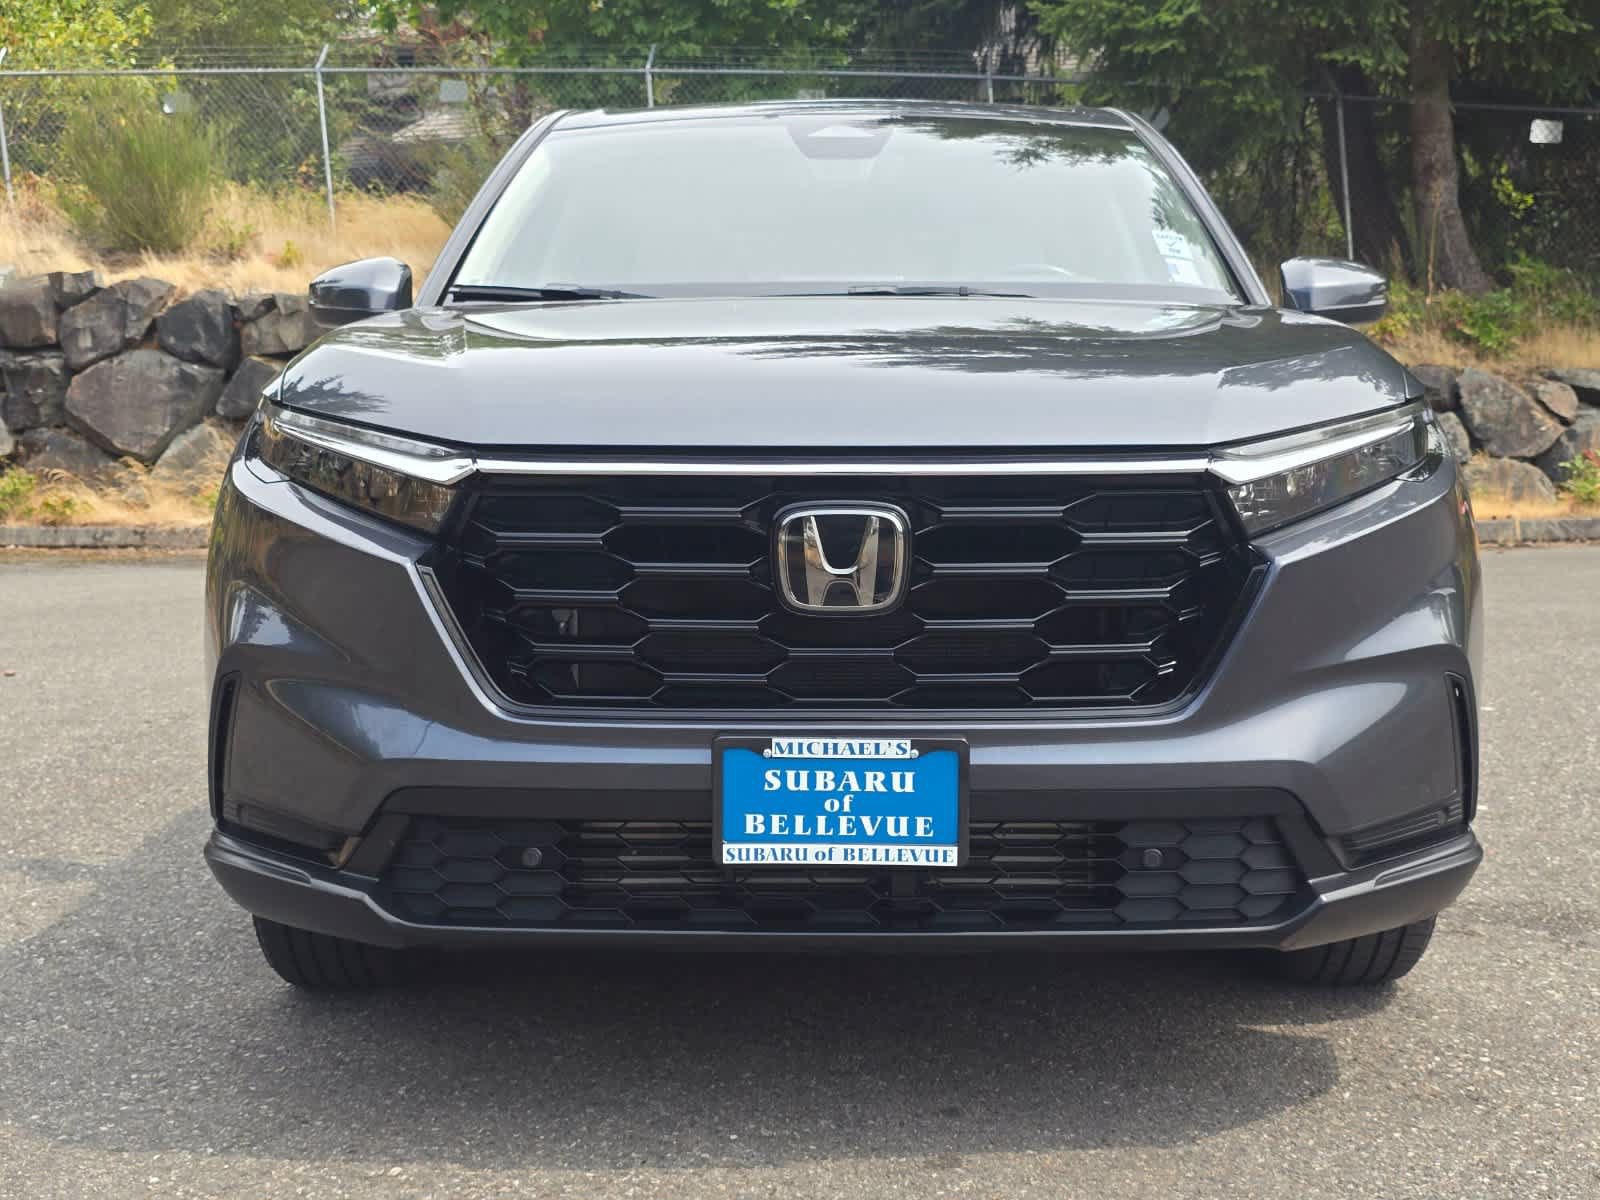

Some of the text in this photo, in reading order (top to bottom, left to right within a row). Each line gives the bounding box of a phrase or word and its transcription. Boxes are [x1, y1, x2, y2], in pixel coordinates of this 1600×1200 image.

[774, 742, 908, 756] MICHAEL'S
[764, 769, 916, 793] SUBARU
[824, 795, 855, 812] of
[744, 814, 935, 837] BELLEVUE
[725, 847, 954, 863] SUBARU of BELLEVUE
